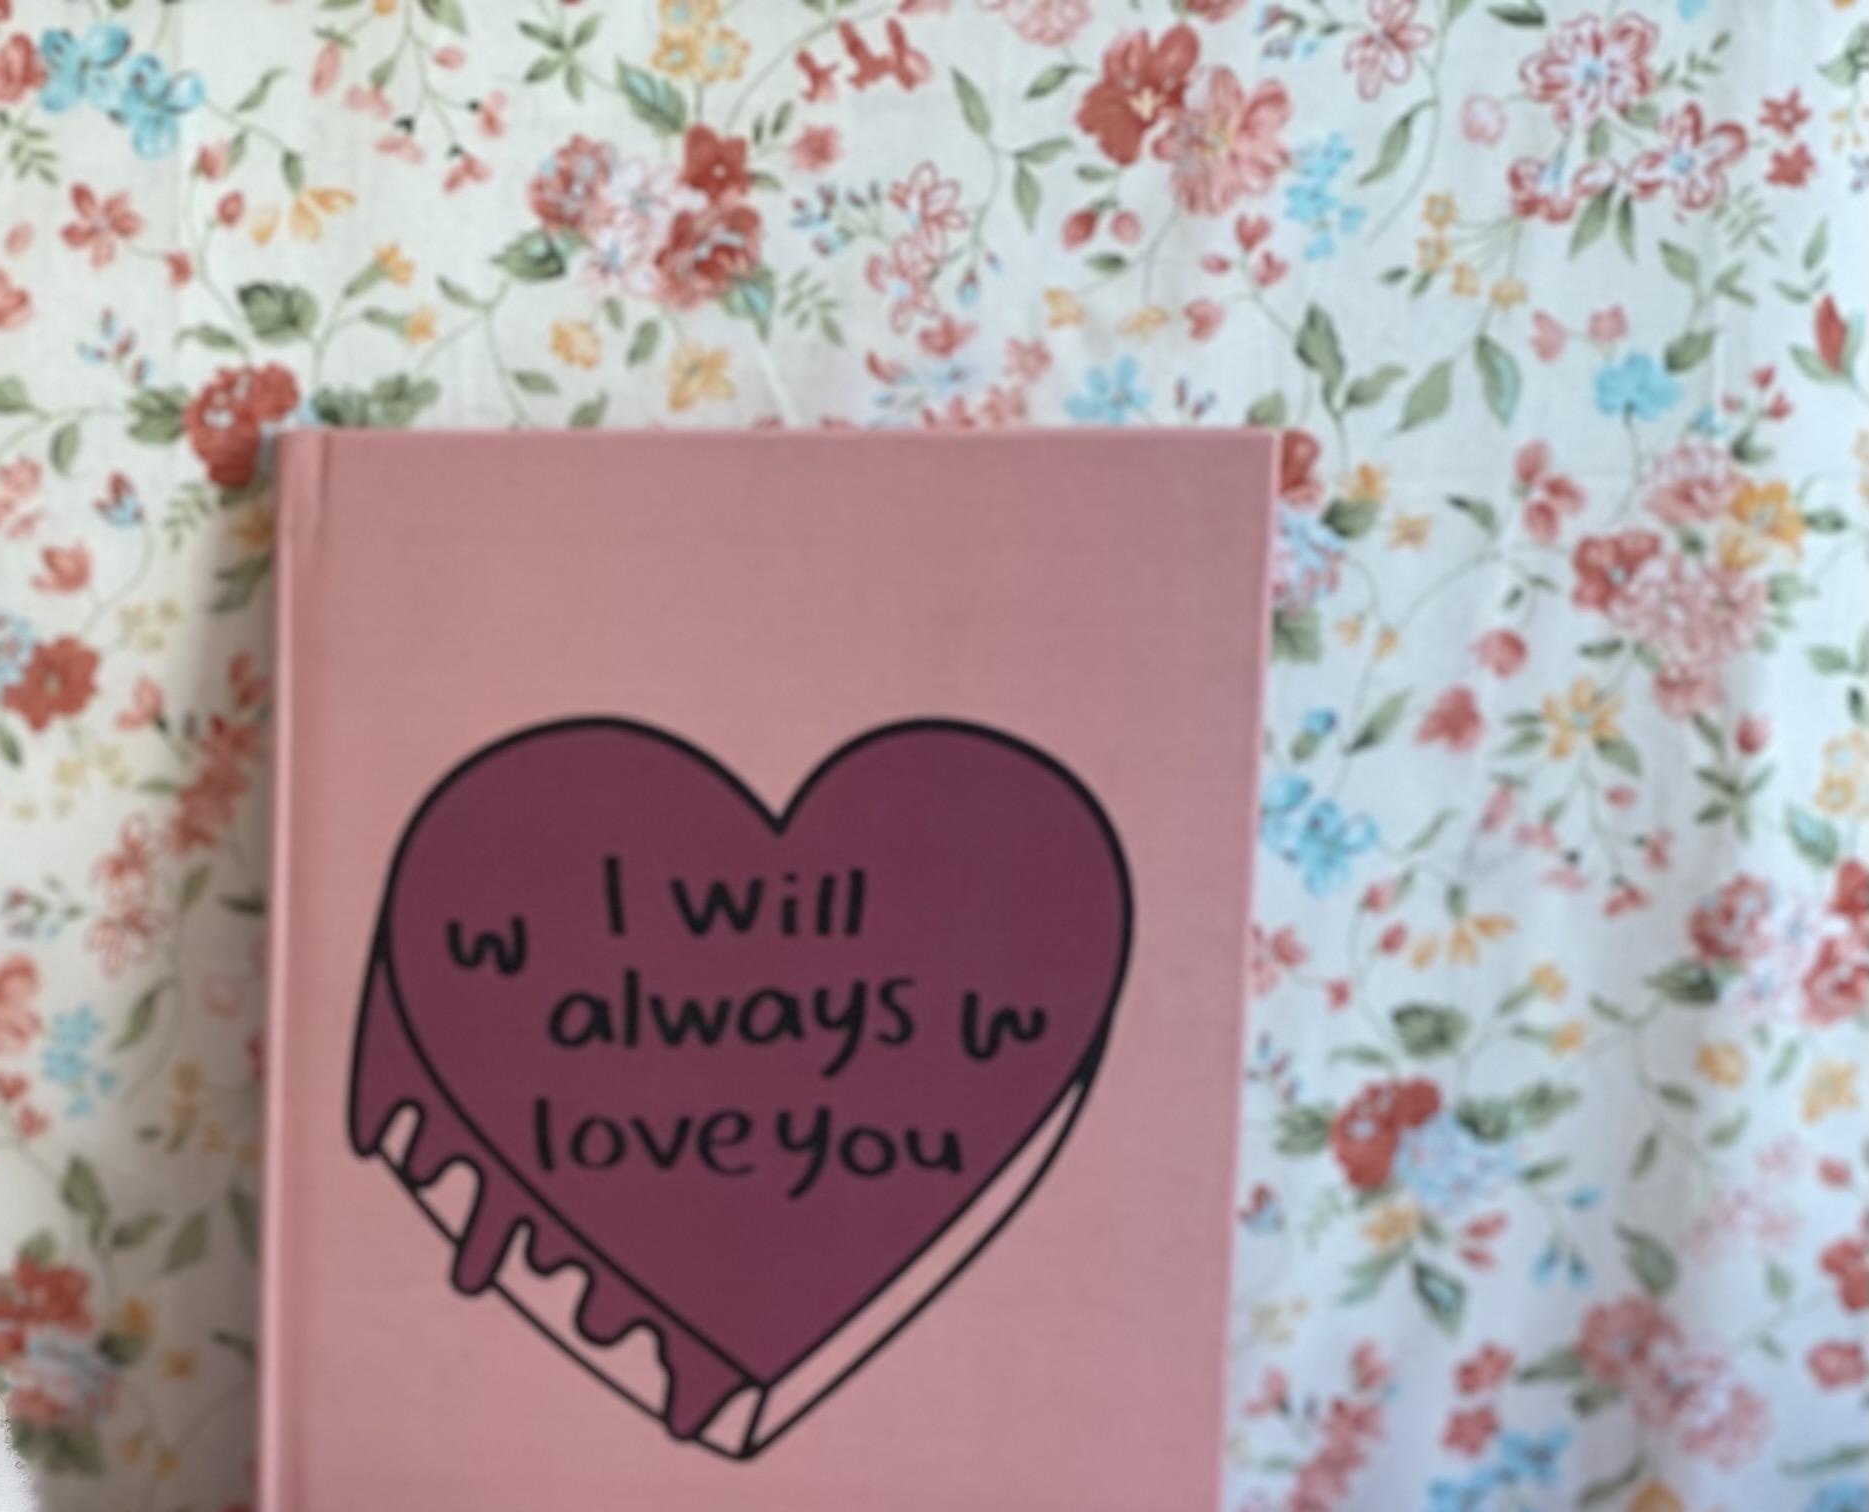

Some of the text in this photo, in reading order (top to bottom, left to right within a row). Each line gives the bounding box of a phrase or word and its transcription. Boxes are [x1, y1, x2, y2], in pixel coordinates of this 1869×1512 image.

[601, 853, 868, 939] I will
[545, 966, 919, 1082] always
